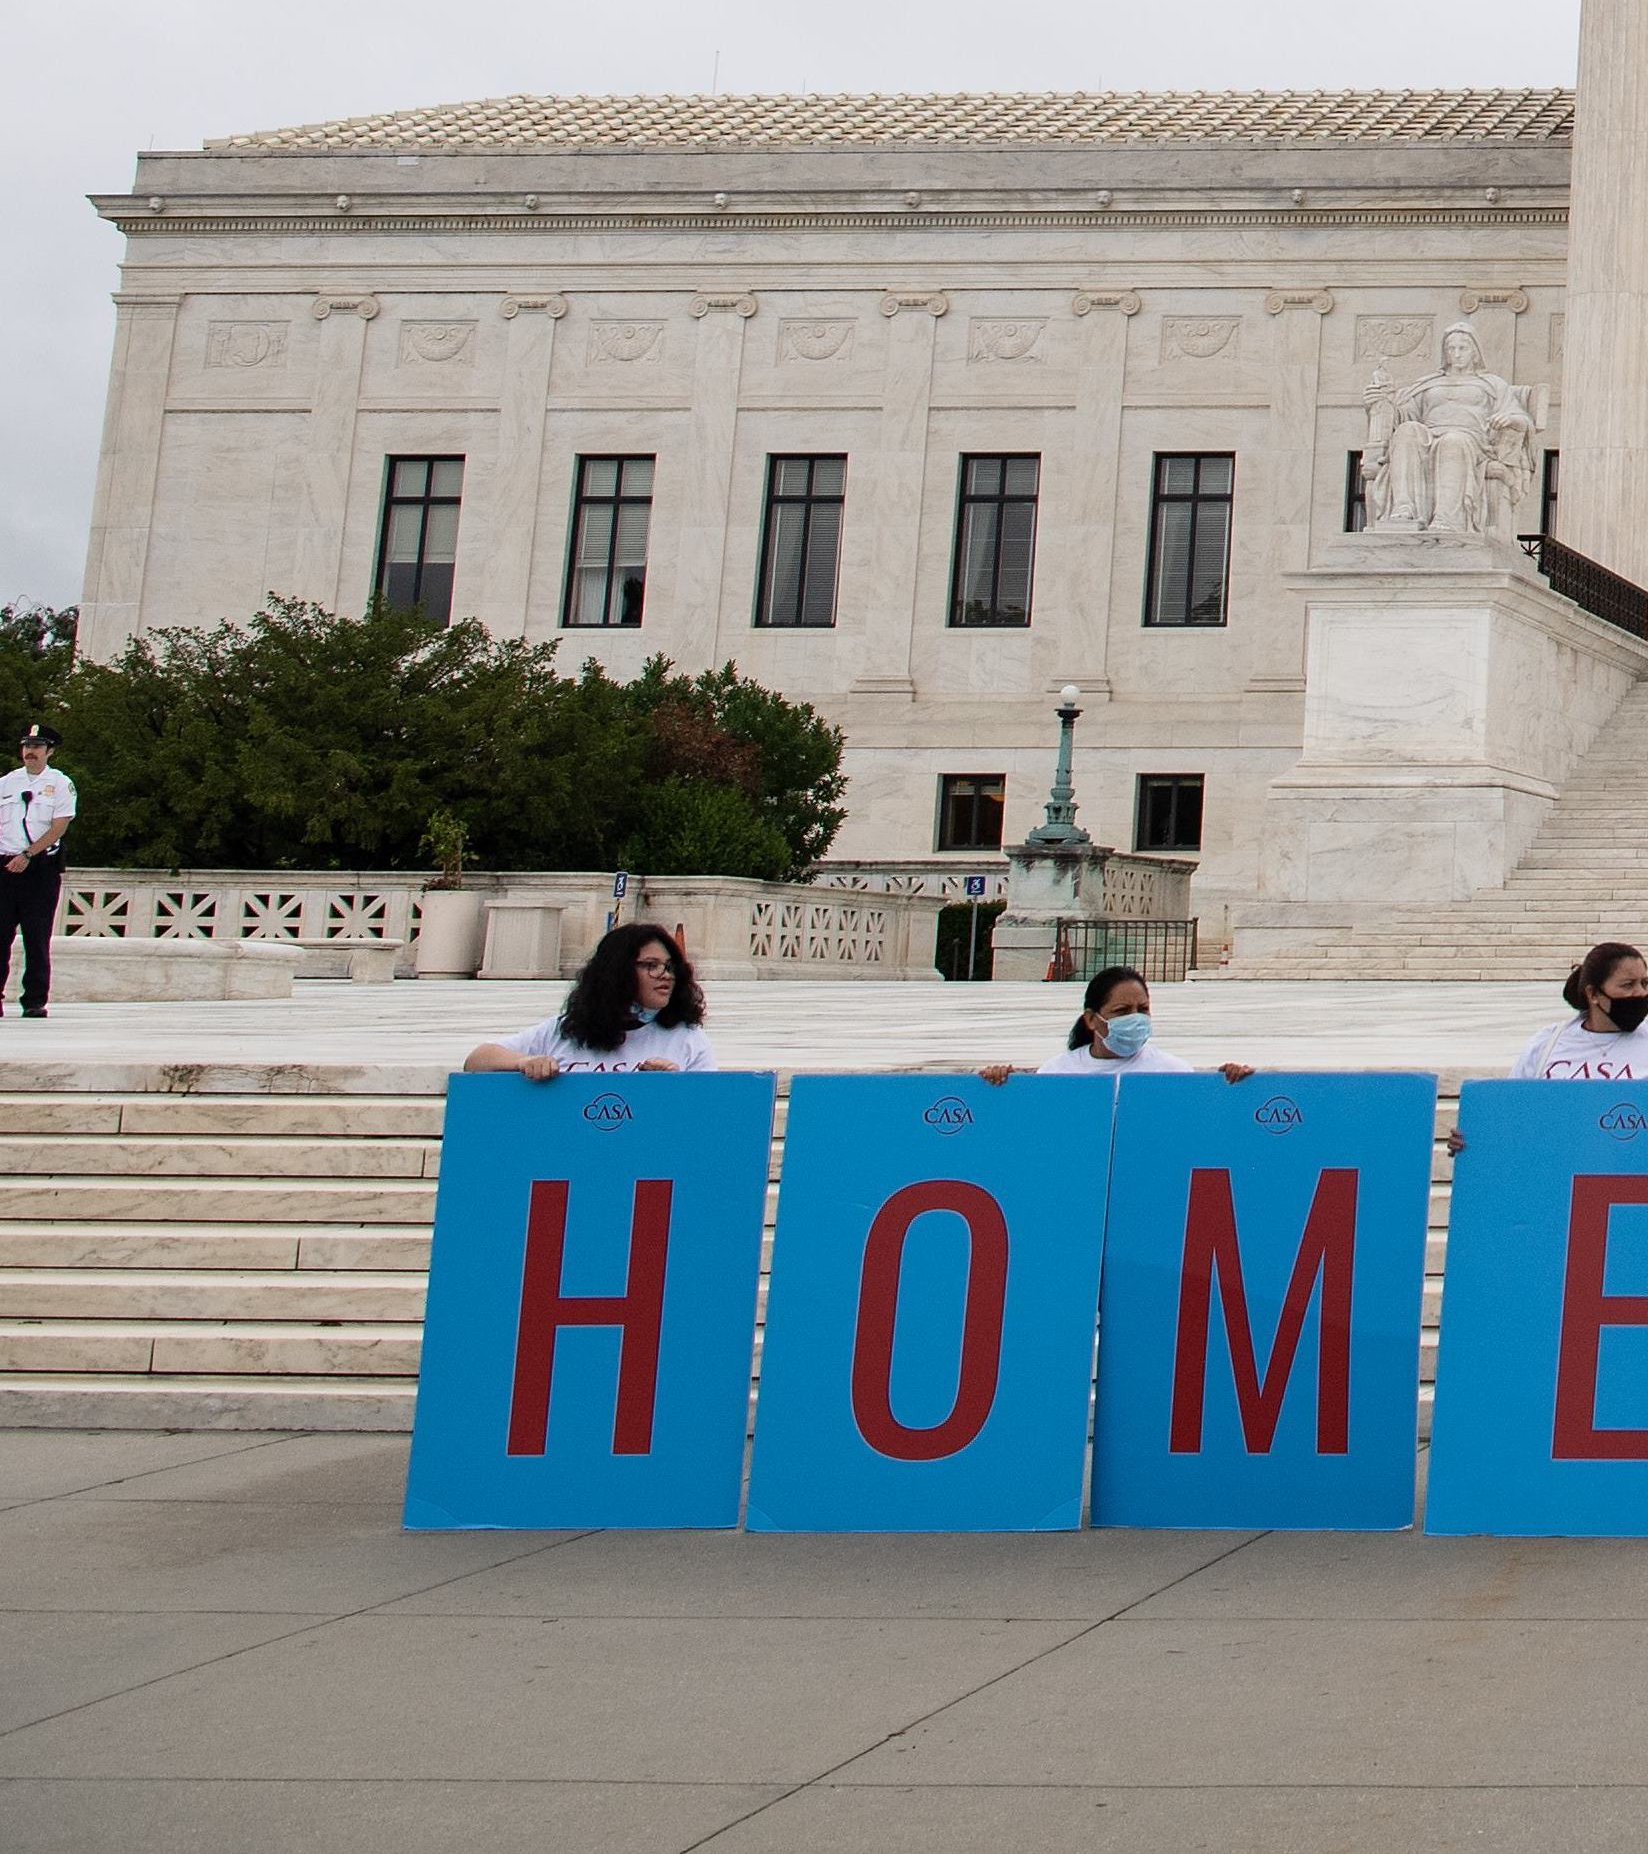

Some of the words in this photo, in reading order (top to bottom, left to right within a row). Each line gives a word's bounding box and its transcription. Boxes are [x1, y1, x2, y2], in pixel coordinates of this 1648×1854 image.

[582, 1103, 633, 1121] CASA
[923, 1107, 974, 1124] CASA
[1253, 1107, 1303, 1123] CASA
[1599, 1114, 1647, 1130] CASA
